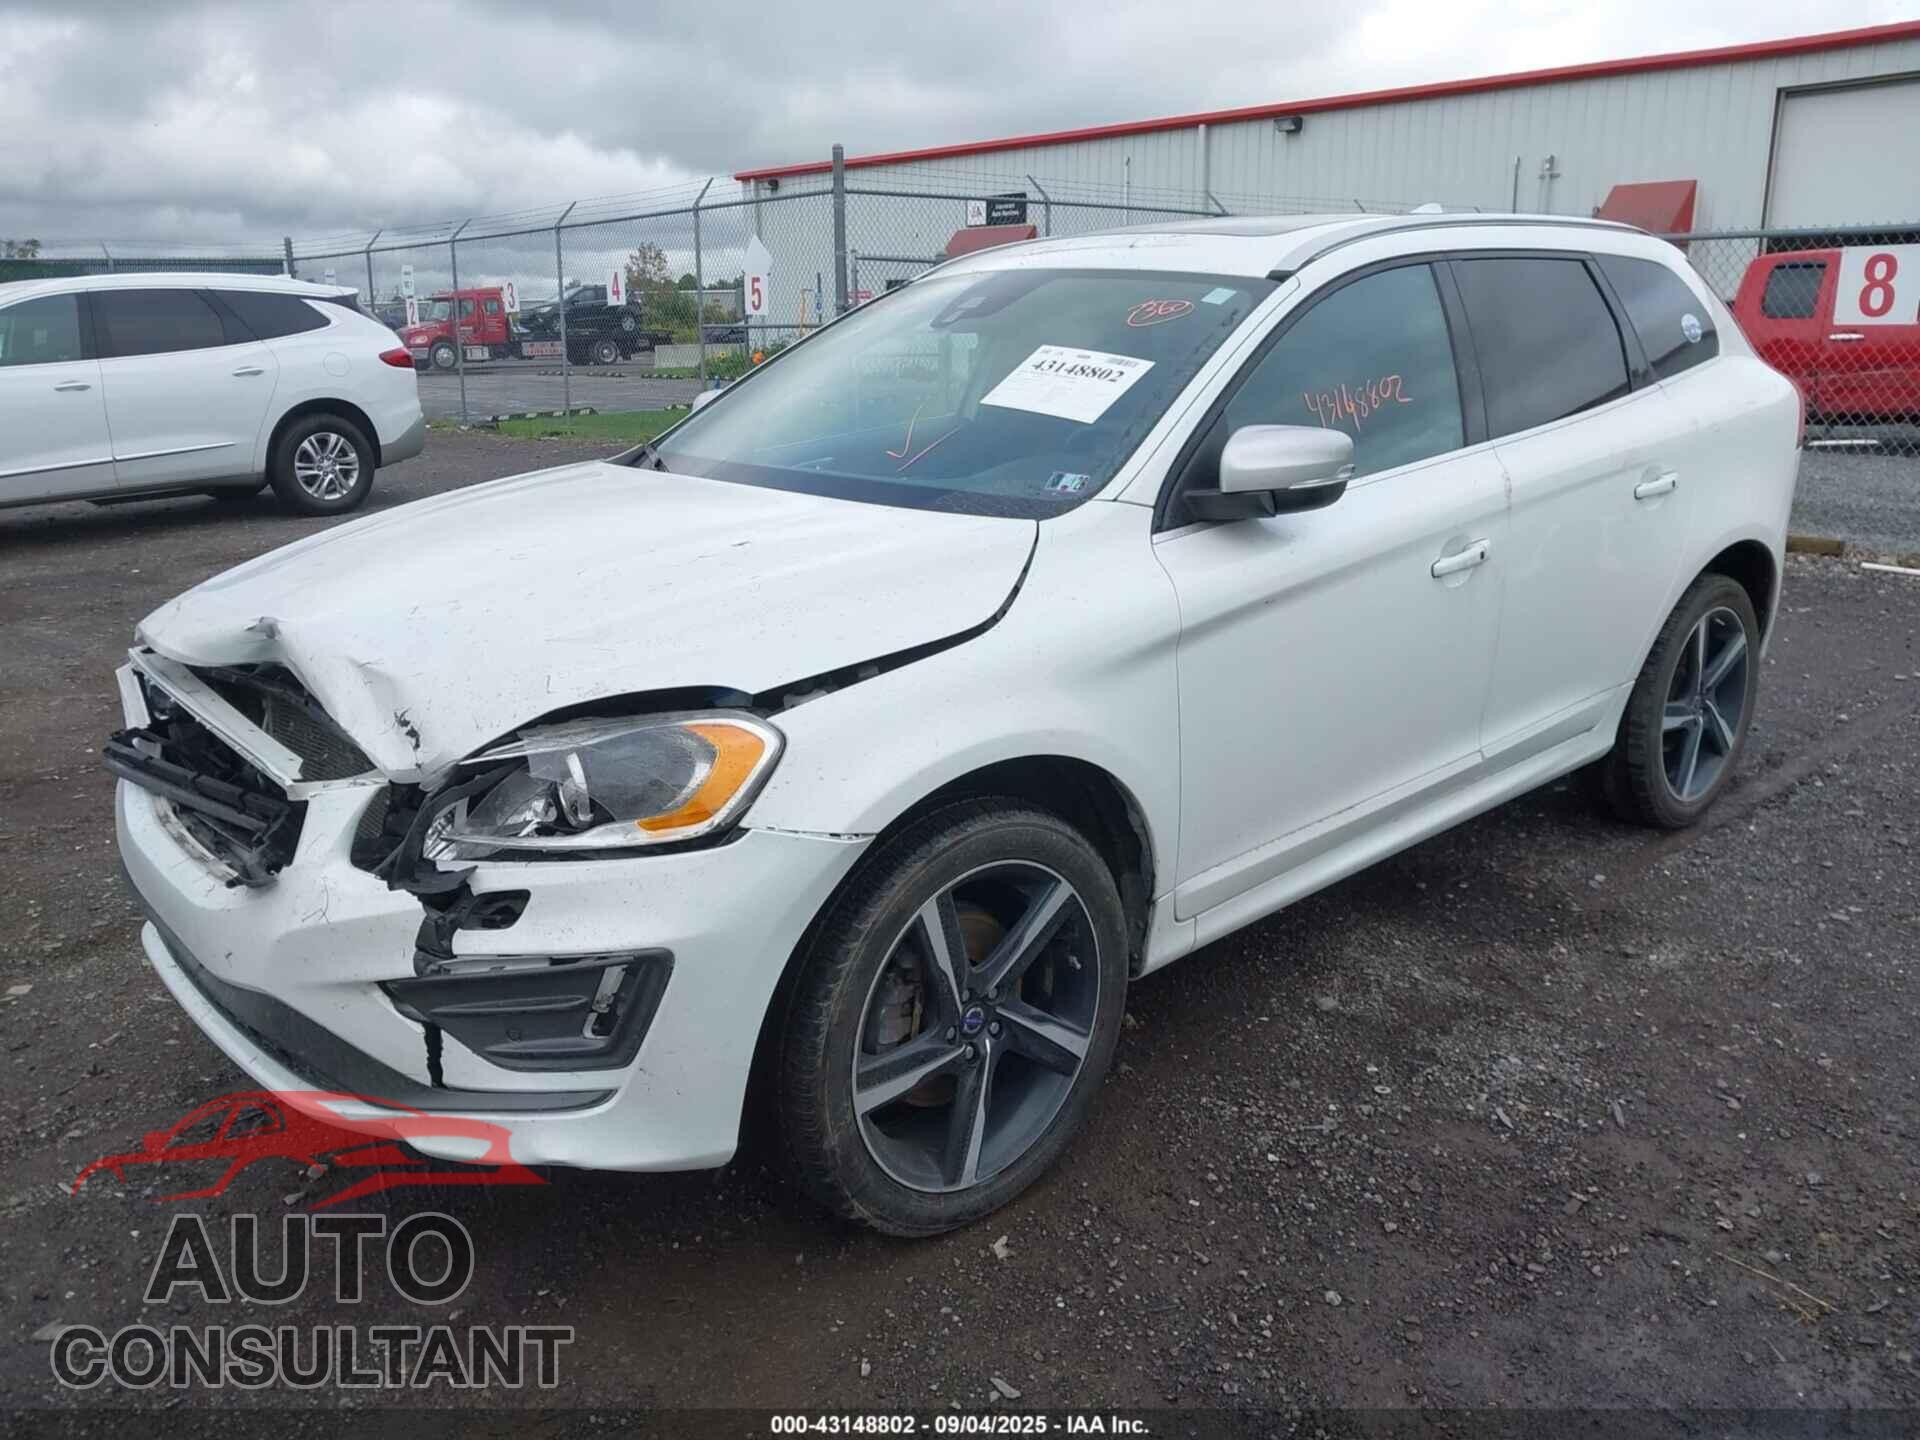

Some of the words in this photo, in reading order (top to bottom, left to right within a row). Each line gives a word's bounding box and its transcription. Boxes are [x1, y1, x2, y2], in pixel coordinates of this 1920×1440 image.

[506, 282, 515, 309] 3
[611, 271, 621, 302] 4
[751, 276, 762, 311] 5
[1858, 253, 1898, 317] 8
[408, 301, 417, 326] 2
[1032, 359, 1125, 383] 43148802
